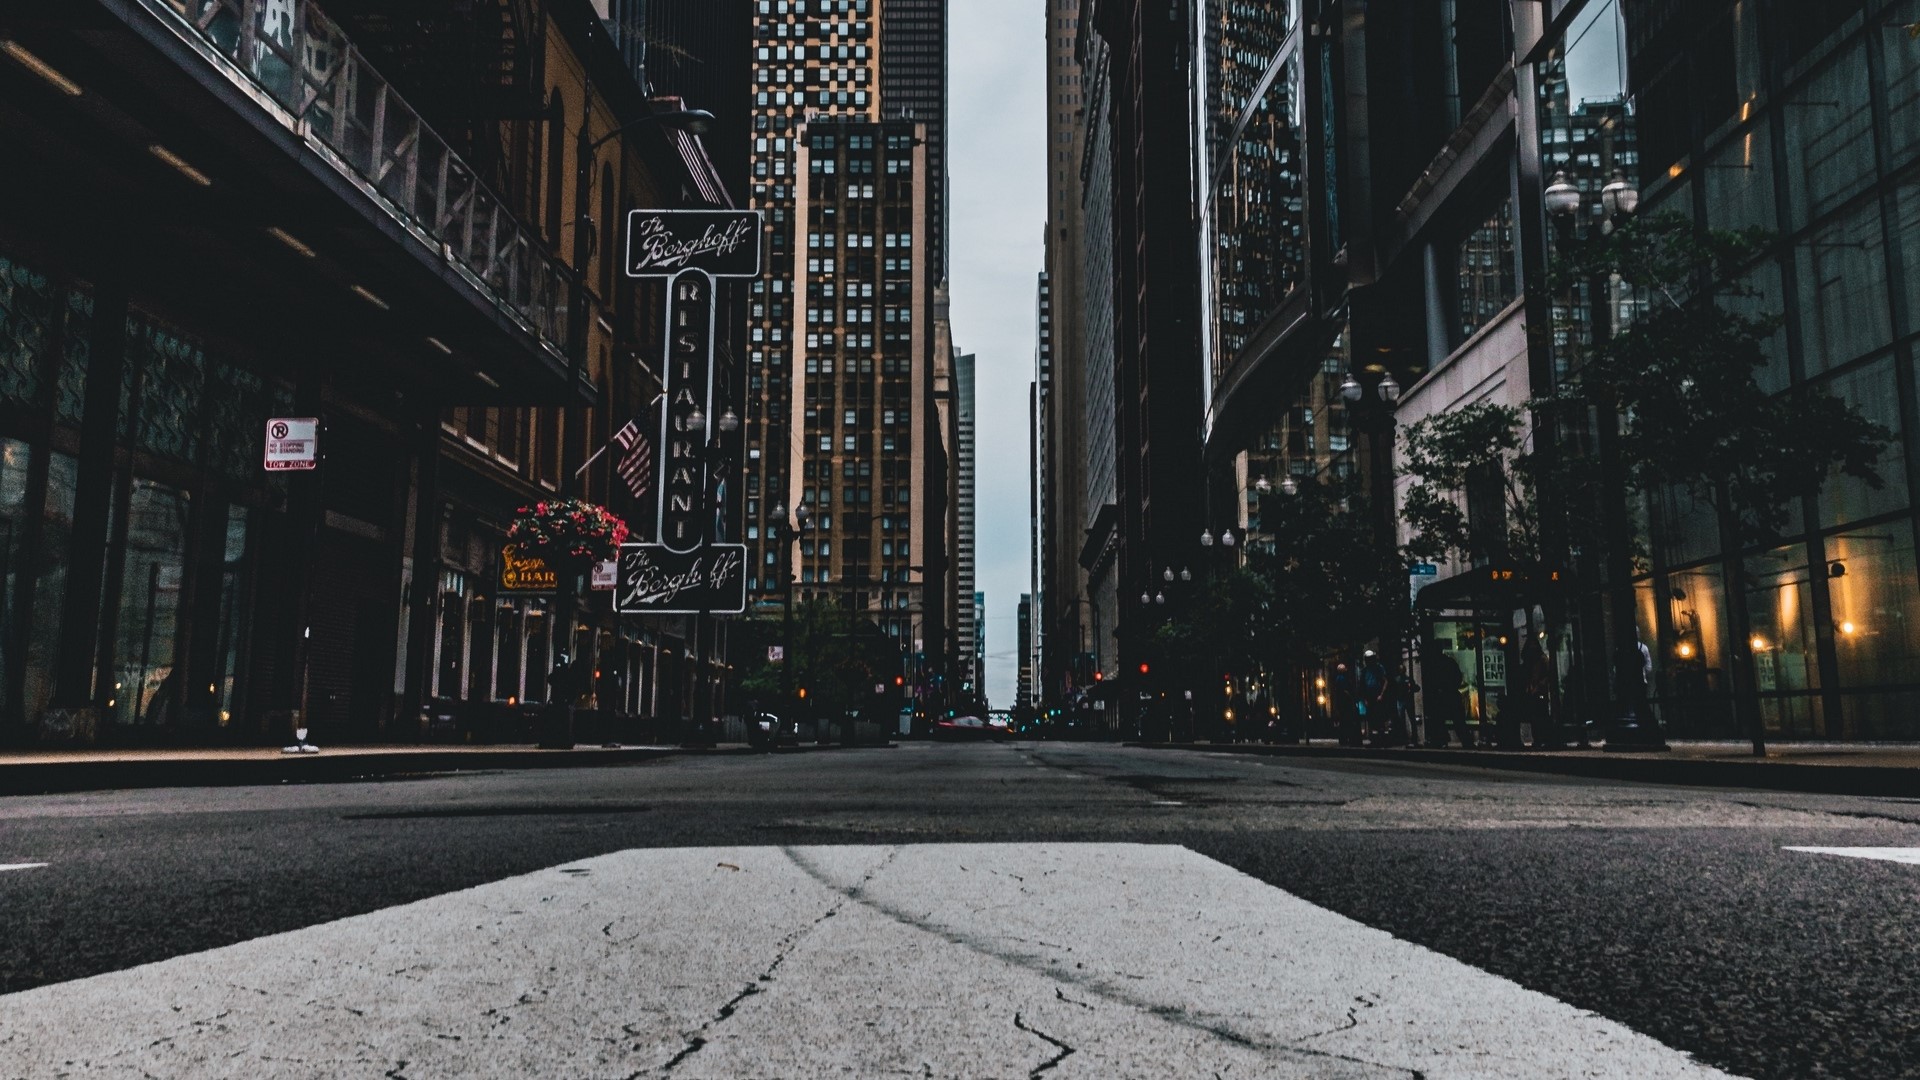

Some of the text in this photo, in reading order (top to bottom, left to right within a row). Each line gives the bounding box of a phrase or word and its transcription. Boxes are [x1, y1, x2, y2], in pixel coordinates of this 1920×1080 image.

[640, 216, 665, 236] The
[625, 549, 650, 570] The
[520, 571, 555, 582] BAR
[1484, 663, 1504, 672] FER
[1485, 672, 1504, 680] ENT
